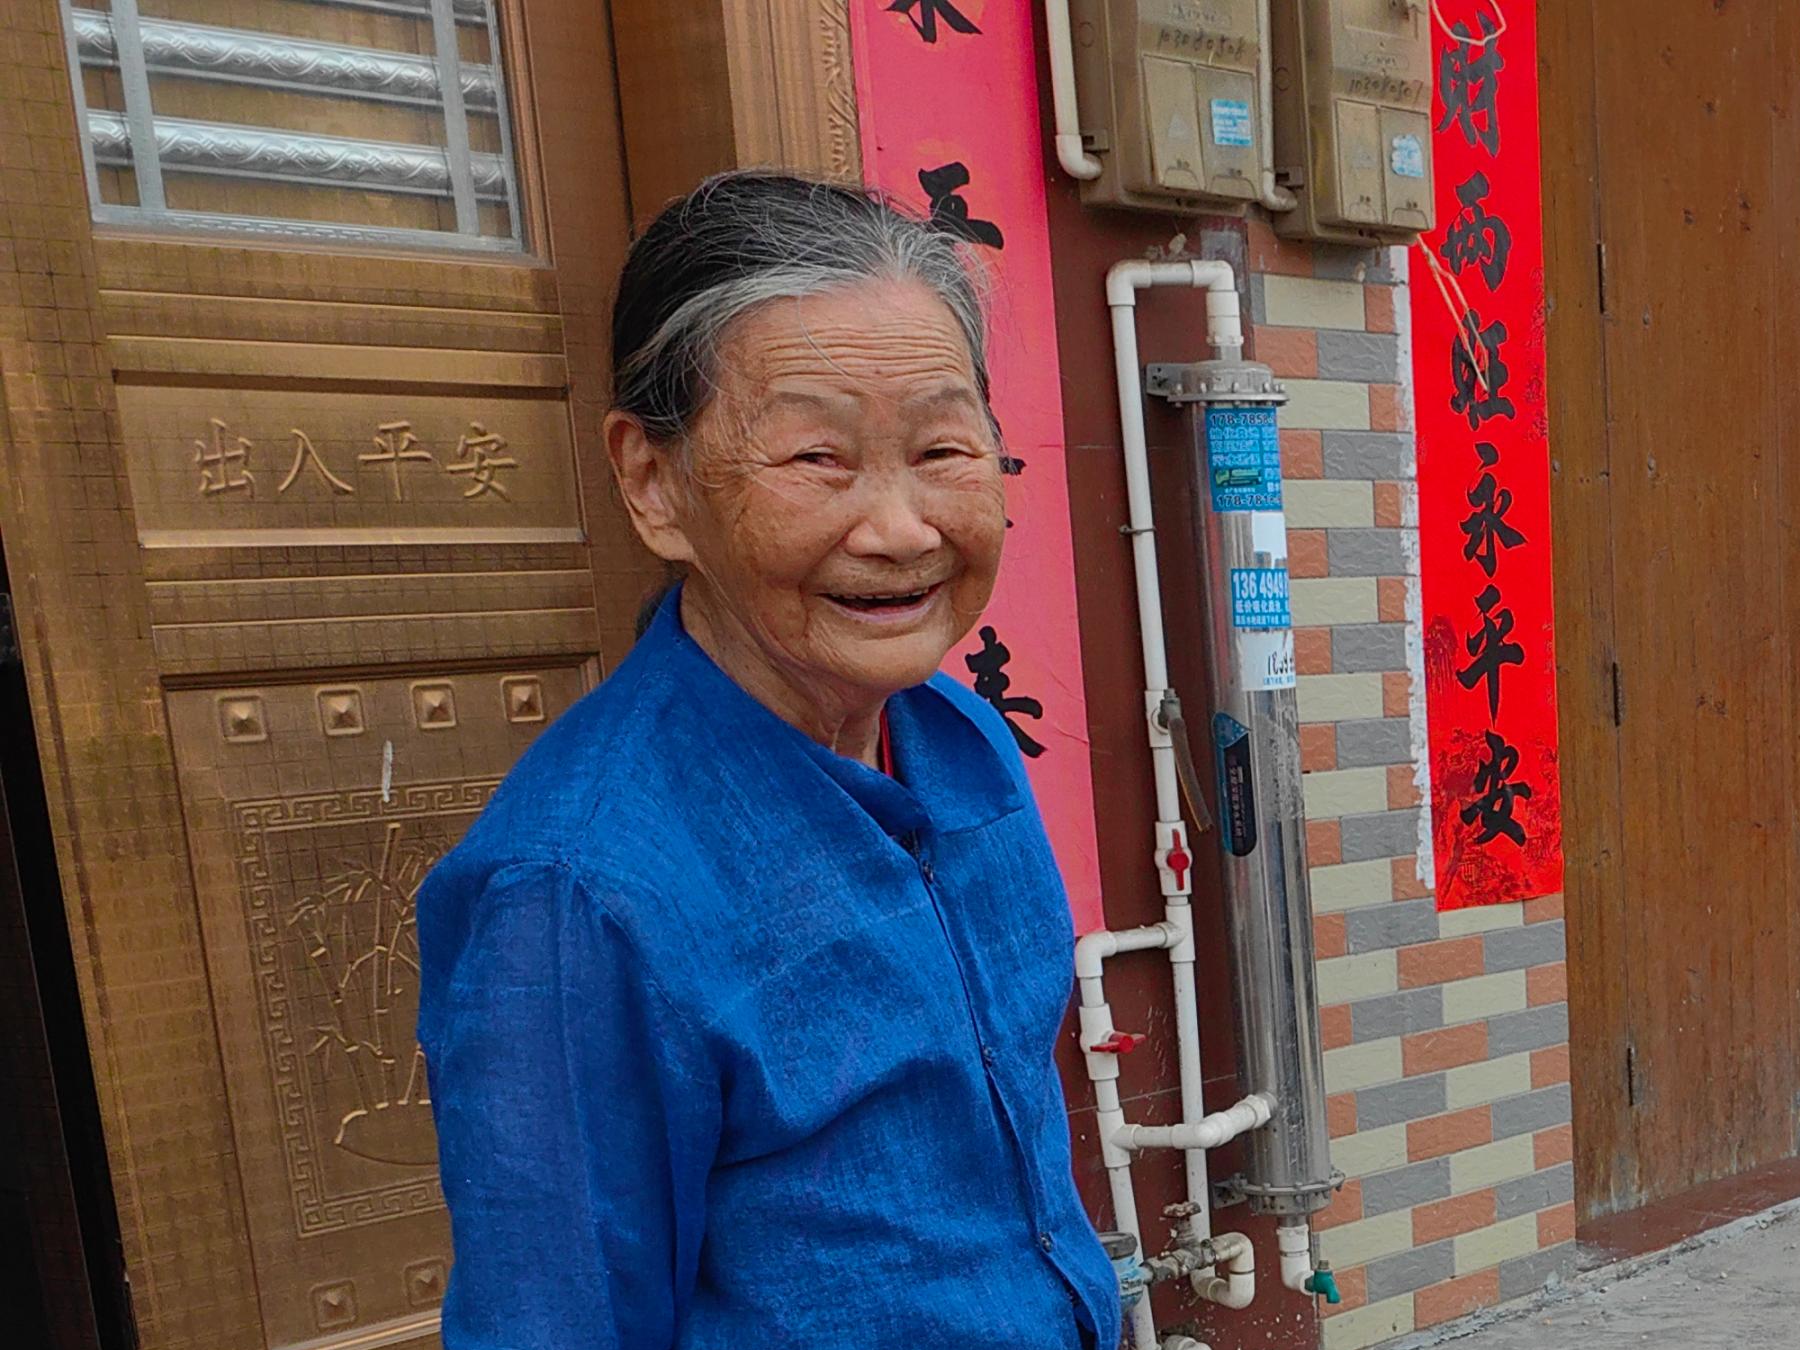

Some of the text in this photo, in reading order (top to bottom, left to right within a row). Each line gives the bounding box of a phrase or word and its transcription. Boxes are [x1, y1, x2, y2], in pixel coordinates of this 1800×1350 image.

[195, 417, 518, 503] 出入平安
[1233, 571, 1257, 599] 136
